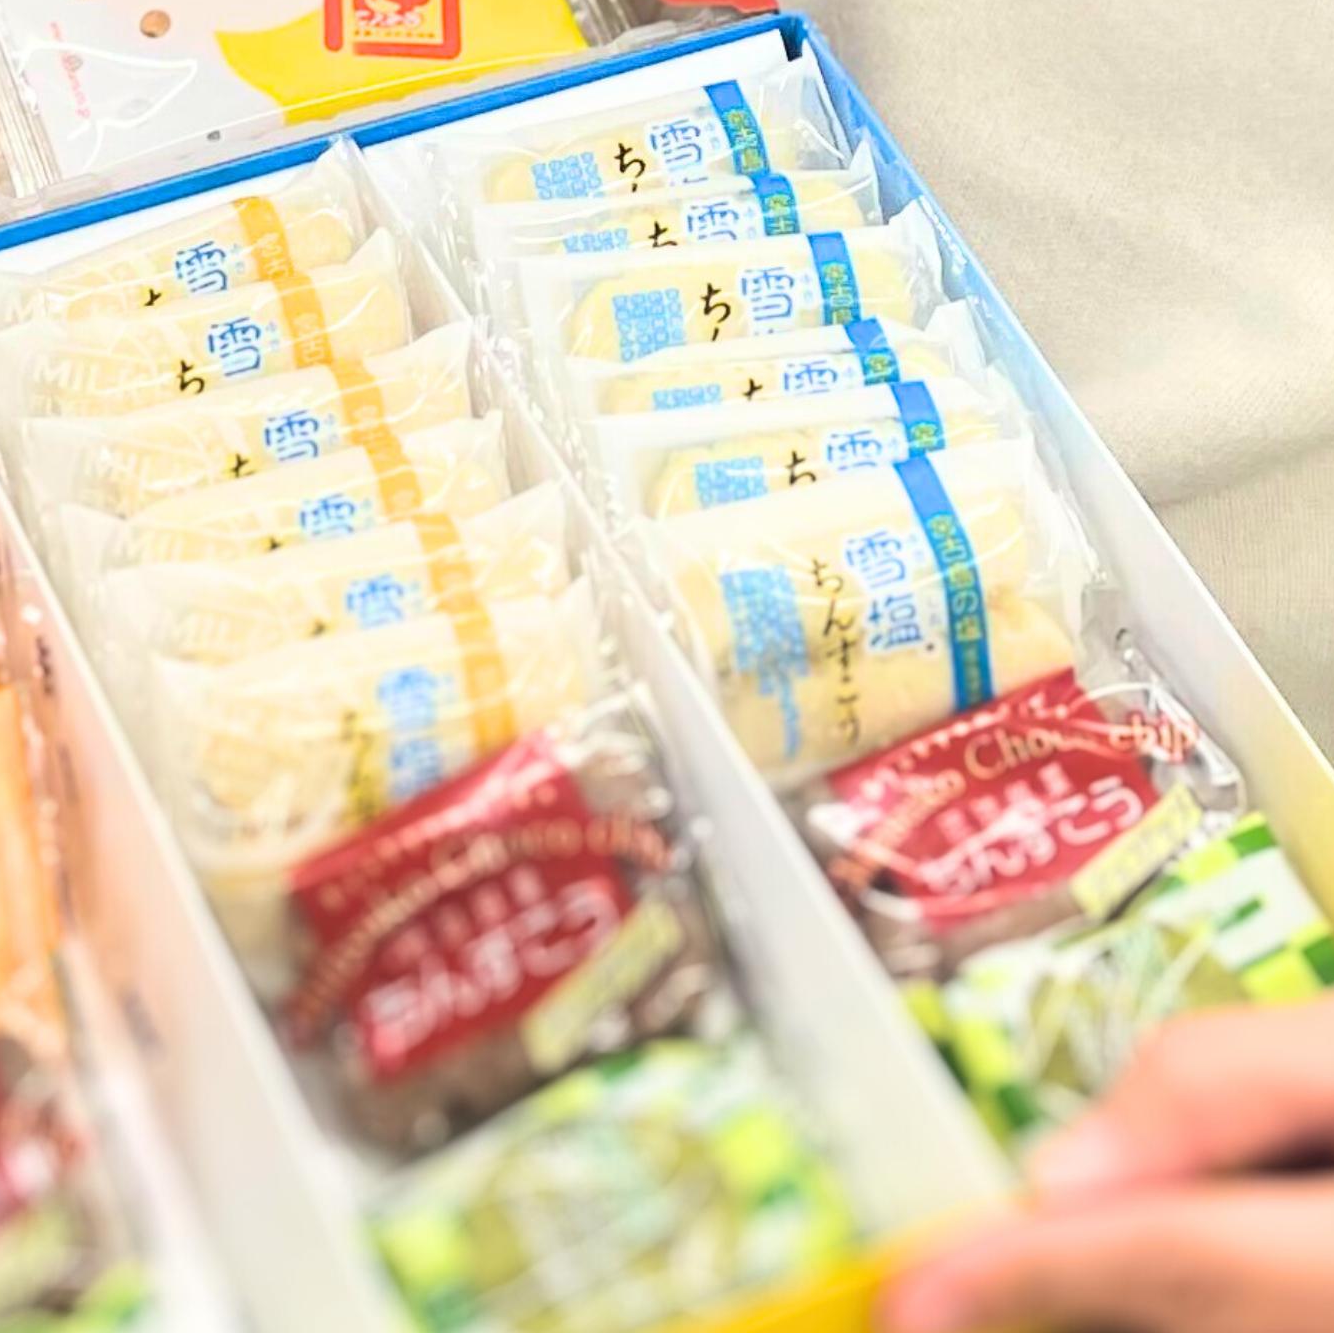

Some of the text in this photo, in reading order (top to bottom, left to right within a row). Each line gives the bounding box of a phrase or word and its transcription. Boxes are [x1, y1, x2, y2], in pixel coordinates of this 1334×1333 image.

[613, 142, 646, 192] ち
[649, 118, 708, 186] 雪
[174, 240, 228, 293] 雪
[741, 267, 795, 335] 雪
[207, 316, 262, 377] 雪
[177, 360, 206, 395] ち
[264, 410, 319, 461] 雪
[845, 530, 923, 649] 雪塩
